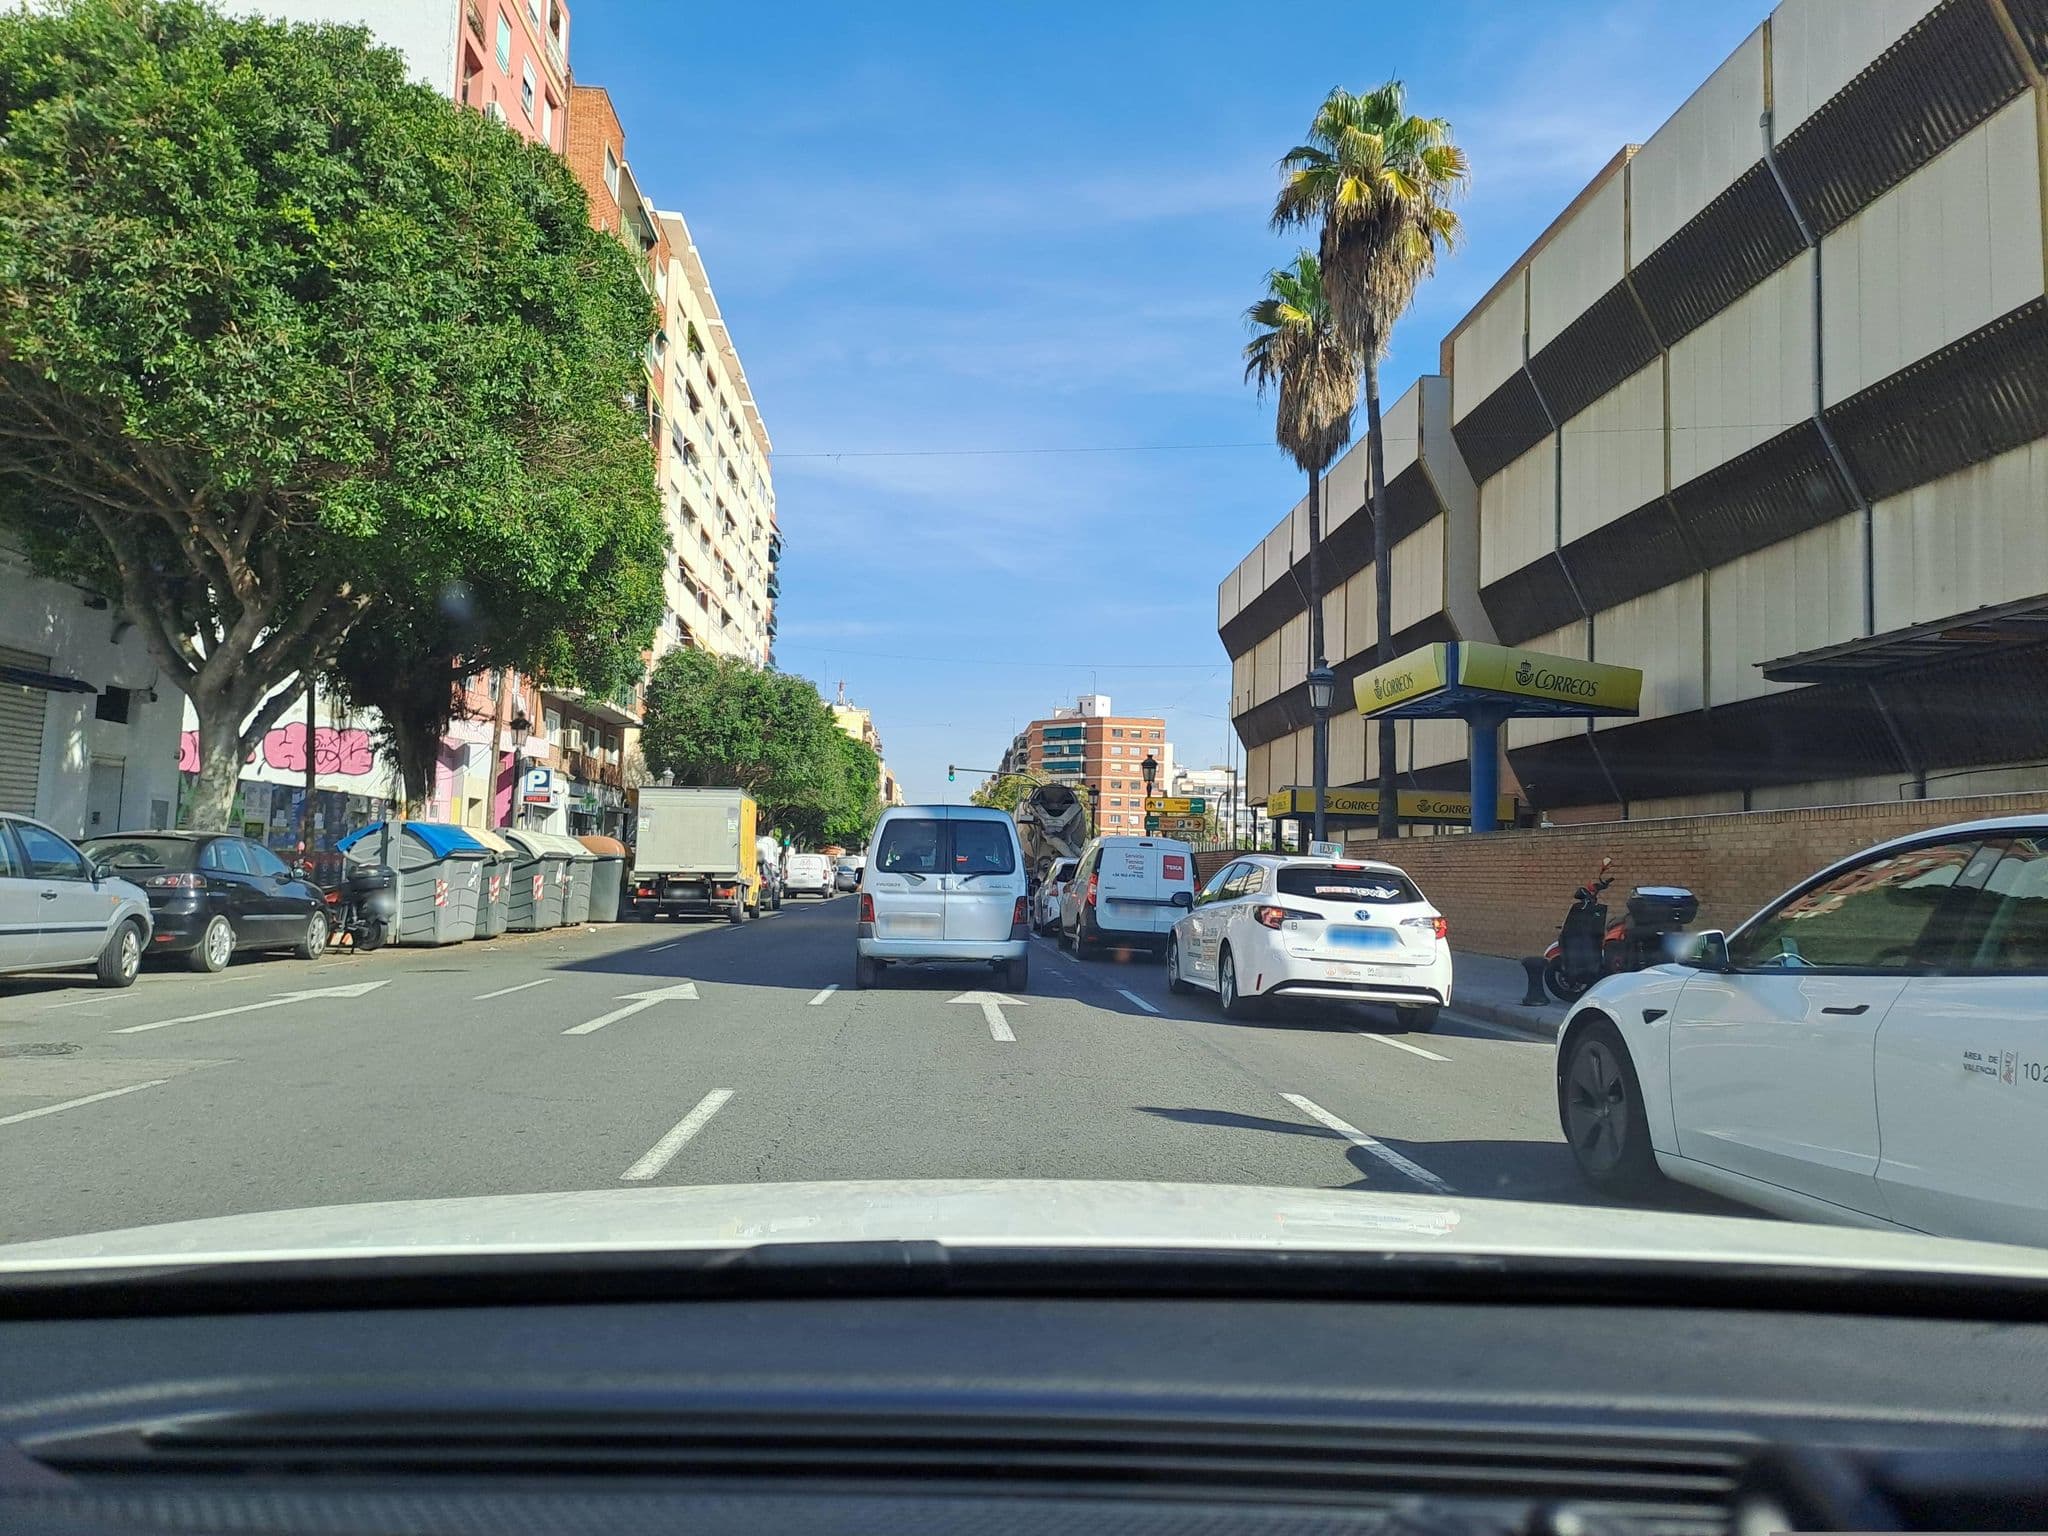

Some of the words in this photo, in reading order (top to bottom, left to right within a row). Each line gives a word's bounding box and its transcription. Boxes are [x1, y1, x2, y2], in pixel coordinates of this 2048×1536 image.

[1382, 672, 1415, 698] CORREOS
[1534, 669, 1599, 697] CORREOS
[1335, 798, 1380, 812] CORREO
[1432, 801, 1472, 815] CORRE
